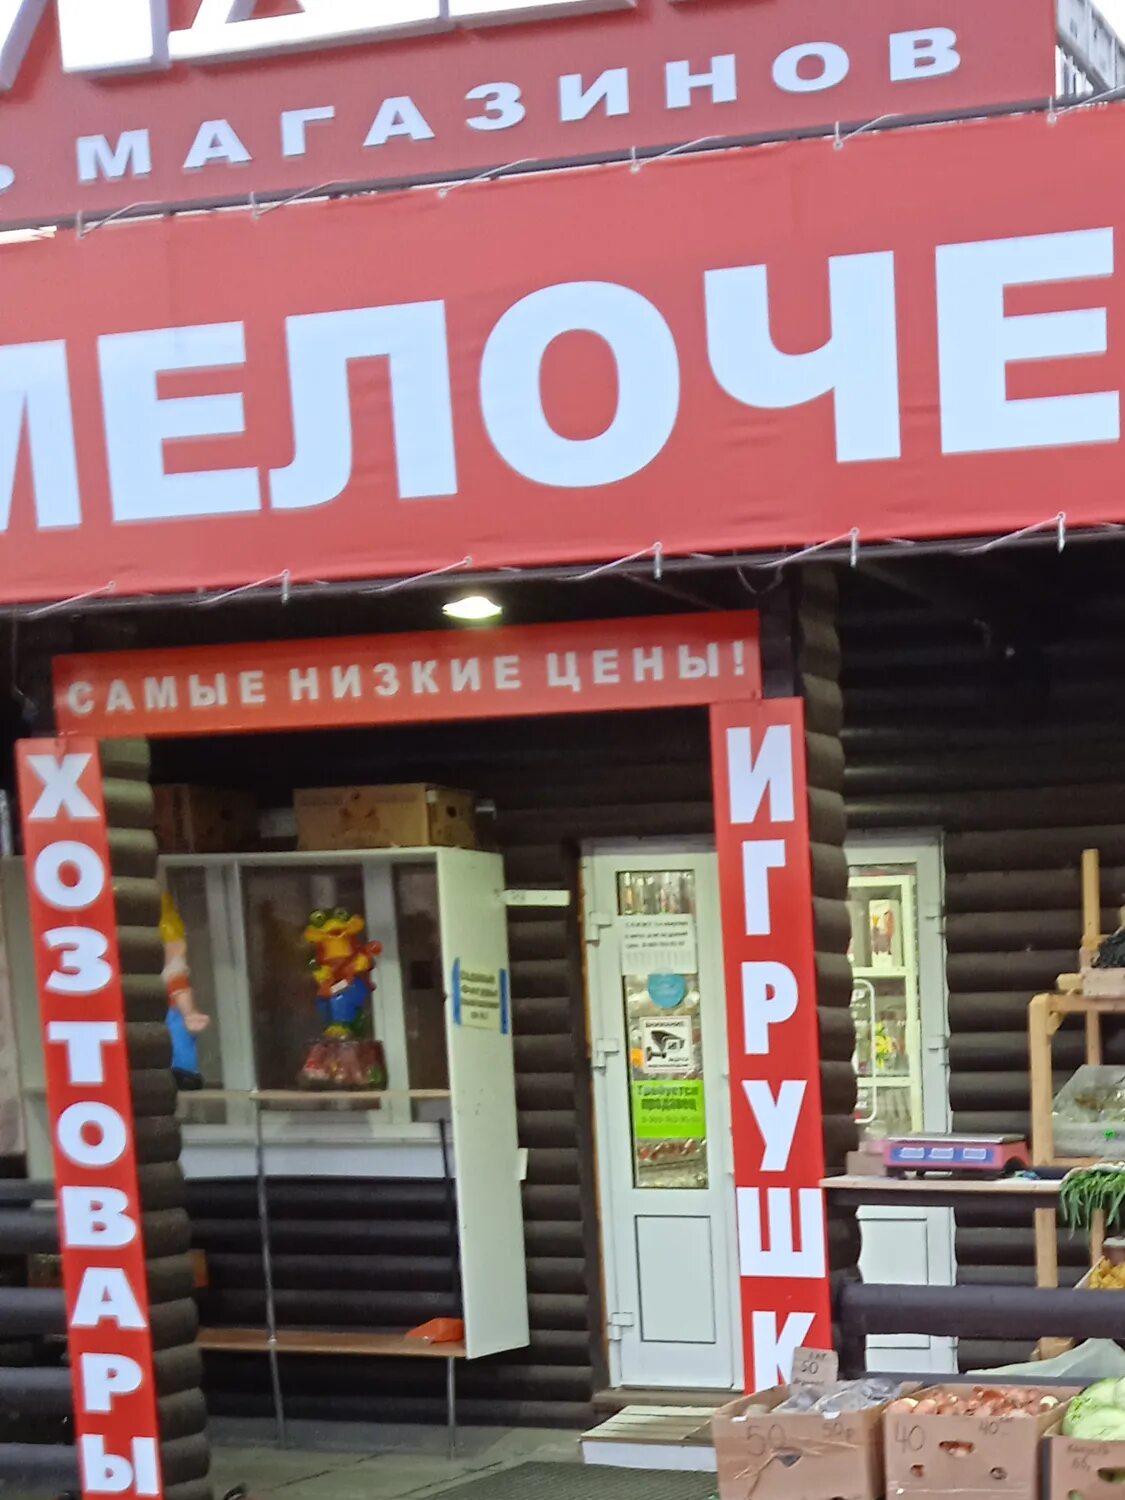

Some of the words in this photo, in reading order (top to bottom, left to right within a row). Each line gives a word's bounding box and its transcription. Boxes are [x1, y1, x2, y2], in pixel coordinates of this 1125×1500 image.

[76, 27, 961, 185] МАГАЗИНОВ
[66, 668, 267, 716] САМЫЕ
[289, 652, 523, 703] НИЗКИЕ
[547, 638, 748, 694] ЦЕНЫ!
[726, 725, 826, 1400] ИГРУШК
[27, 753, 160, 1496] ХОЗТОВАРЫ
[747, 1423, 787, 1457] 50
[893, 1419, 926, 1454] 40
